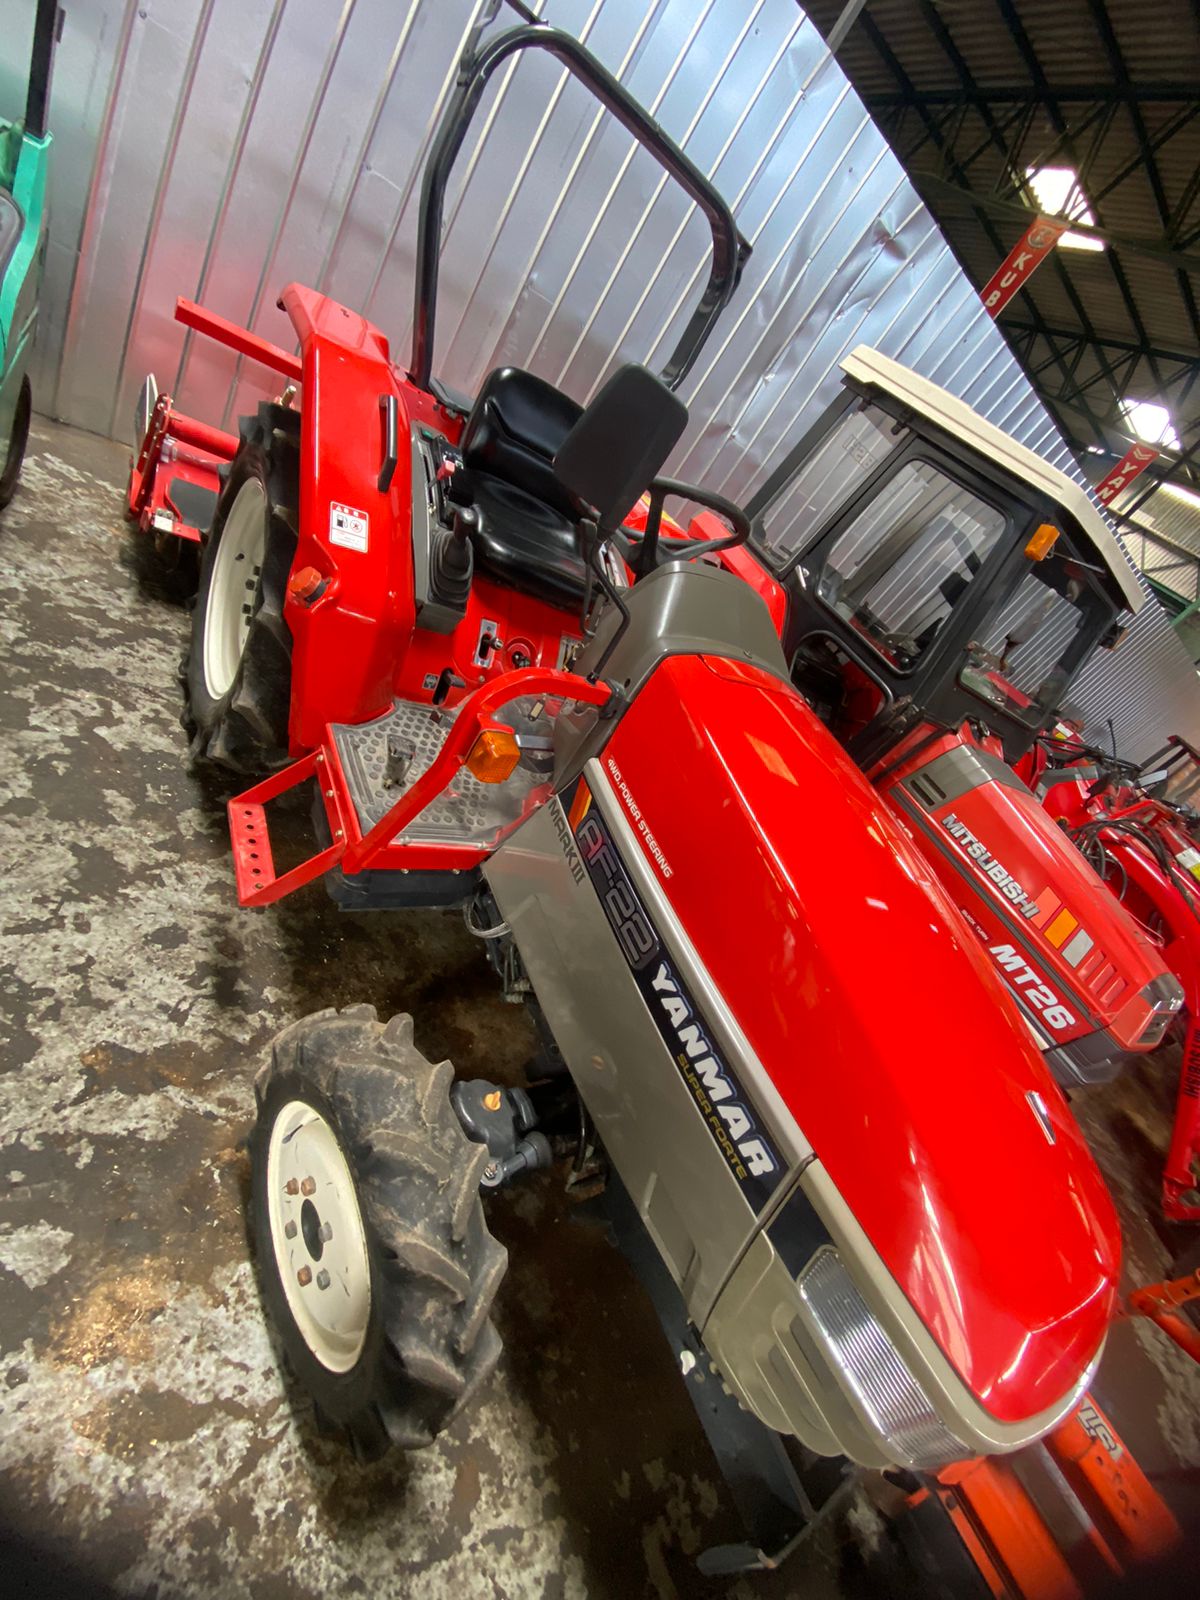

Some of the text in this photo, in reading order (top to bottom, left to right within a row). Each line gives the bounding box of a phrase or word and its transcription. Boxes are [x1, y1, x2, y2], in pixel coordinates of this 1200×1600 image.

[638, 819, 674, 879] STEERING
[941, 813, 1039, 919] MITSUBISHI
[989, 943, 1076, 1030] MT26
[651, 960, 776, 1178] YANMAR
[677, 1052, 748, 1181] SUPER FORTE
